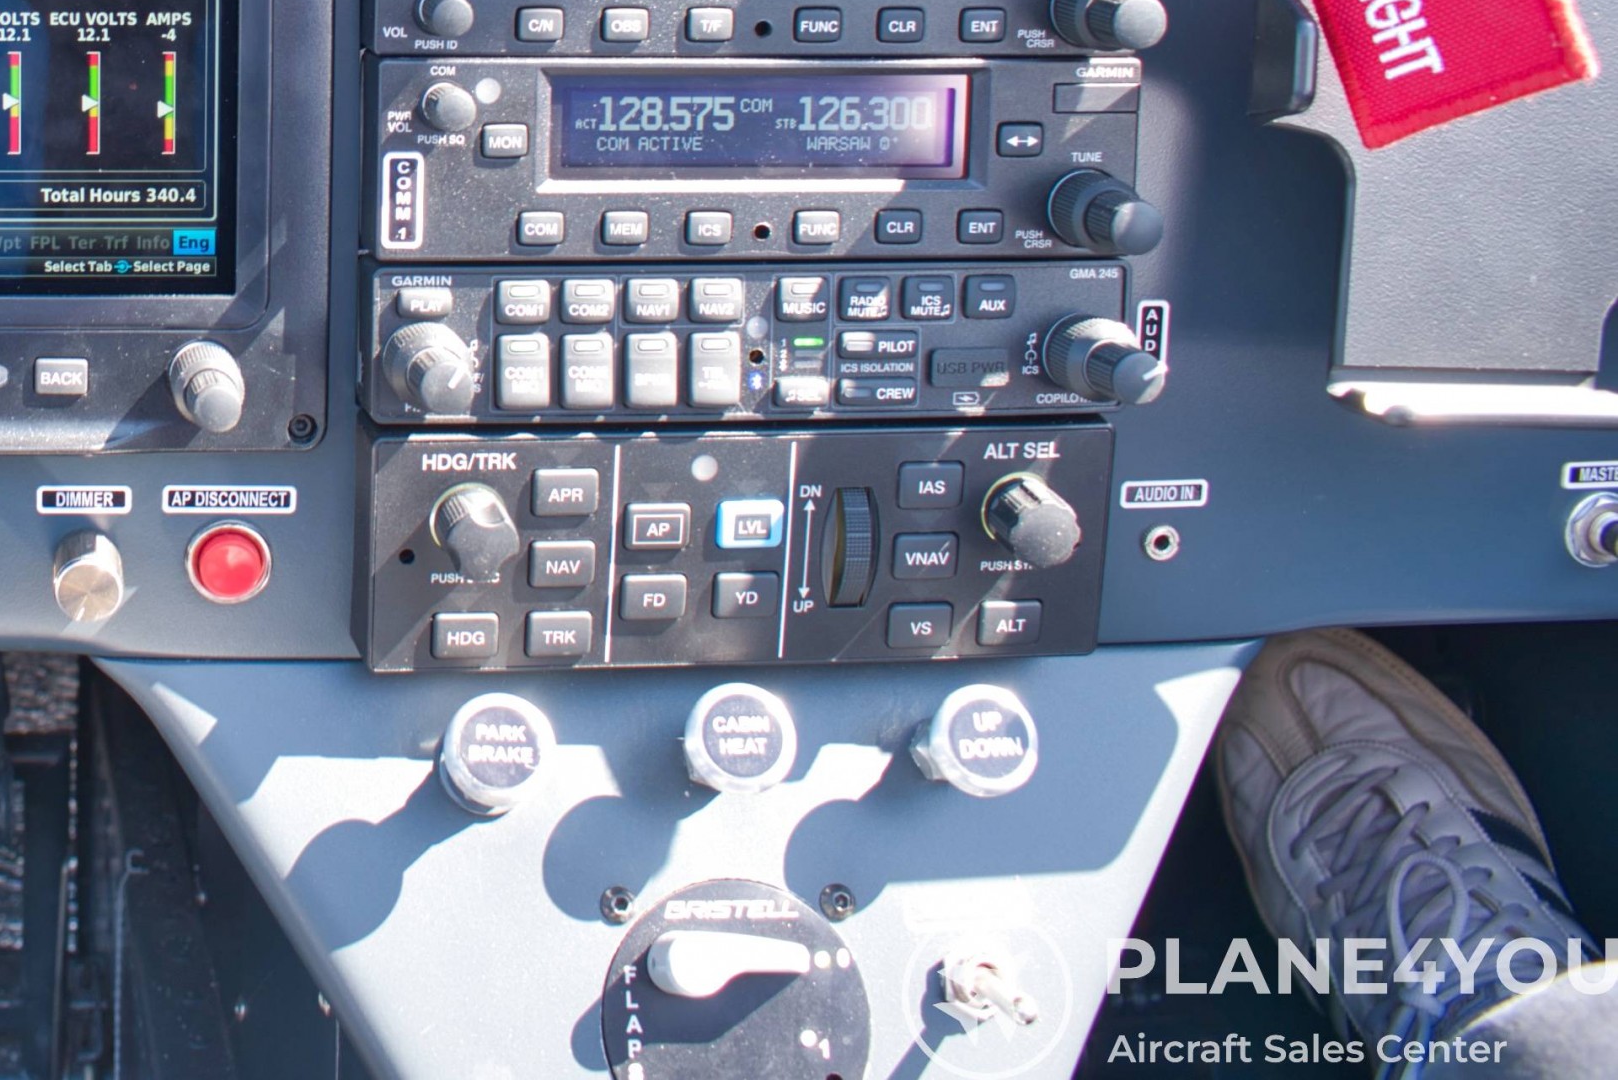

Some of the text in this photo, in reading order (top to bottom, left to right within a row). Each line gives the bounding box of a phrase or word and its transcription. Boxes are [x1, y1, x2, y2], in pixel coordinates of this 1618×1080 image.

[382, 26, 408, 39] VOL
[800, 20, 839, 33] FUNC
[888, 19, 916, 33] CLR
[970, 20, 999, 33] ENT
[1017, 29, 1046, 40] PUSH
[488, 135, 523, 149] MON
[596, 136, 703, 152] COM ACTIVE
[1070, 151, 1103, 164] TUNE
[41, 187, 197, 204] Total Hours 340.4
[885, 221, 914, 234] CLR
[968, 221, 996, 235] ENT
[1014, 229, 1044, 240] PUSH
[391, 275, 453, 287] GARMIN
[782, 301, 826, 316] MUSIC
[979, 299, 1006, 312] AUX
[878, 340, 915, 353] PILOT
[936, 361, 1006, 375] USB PWR
[40, 371, 83, 386] BACK
[875, 387, 915, 400] CREW
[983, 441, 1060, 460] ALT SEL
[421, 452, 517, 472] HDG/TRK
[918, 480, 946, 495] IAS
[55, 491, 113, 507] DIMMER
[171, 491, 287, 507] AP DISCONNECT
[548, 488, 584, 503] APR
[905, 551, 949, 566] VNAV
[545, 560, 581, 575] NAV
[642, 593, 666, 607] FD
[735, 591, 758, 605] YD
[792, 600, 814, 613] UP
[909, 621, 932, 636] VS
[446, 631, 485, 646] HDG
[542, 630, 576, 645] TRK
[711, 715, 771, 735] CABIN
[973, 711, 1002, 731] UP
[474, 724, 527, 742] PARK
[718, 737, 768, 756] HEAT
[468, 745, 534, 765] BRAKE
[663, 899, 800, 920] BRISTELL
